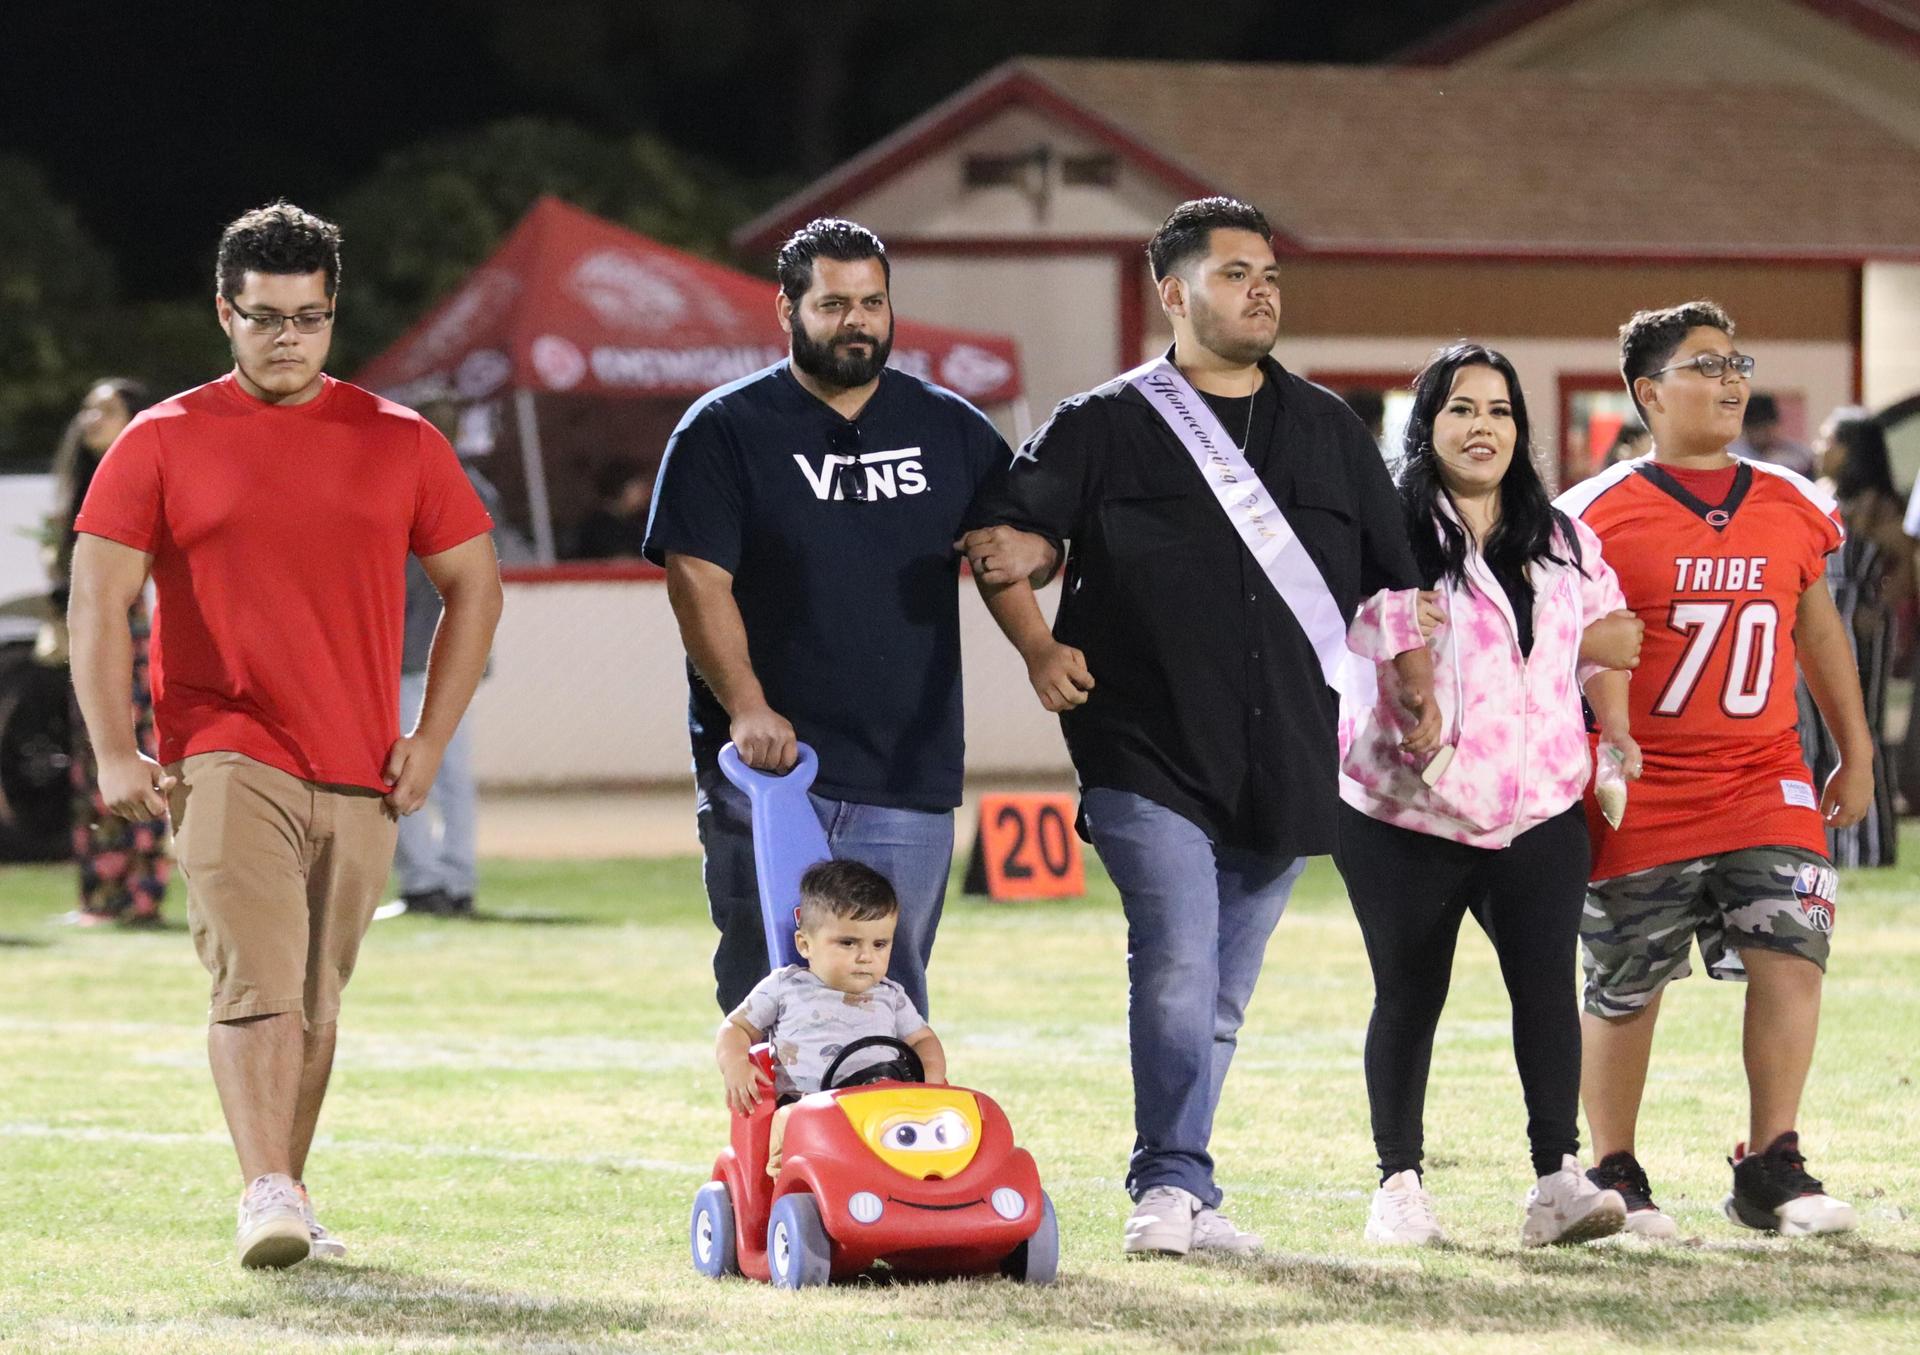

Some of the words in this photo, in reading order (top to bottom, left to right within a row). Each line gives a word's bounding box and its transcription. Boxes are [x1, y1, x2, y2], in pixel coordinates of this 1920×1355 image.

[1143, 374, 1238, 484] Homecoming
[793, 446, 928, 501] VNS
[1705, 509, 1730, 526] C
[1674, 556, 1768, 592] TRIBE
[1650, 599, 1780, 719] 70
[997, 804, 1070, 879] 20
